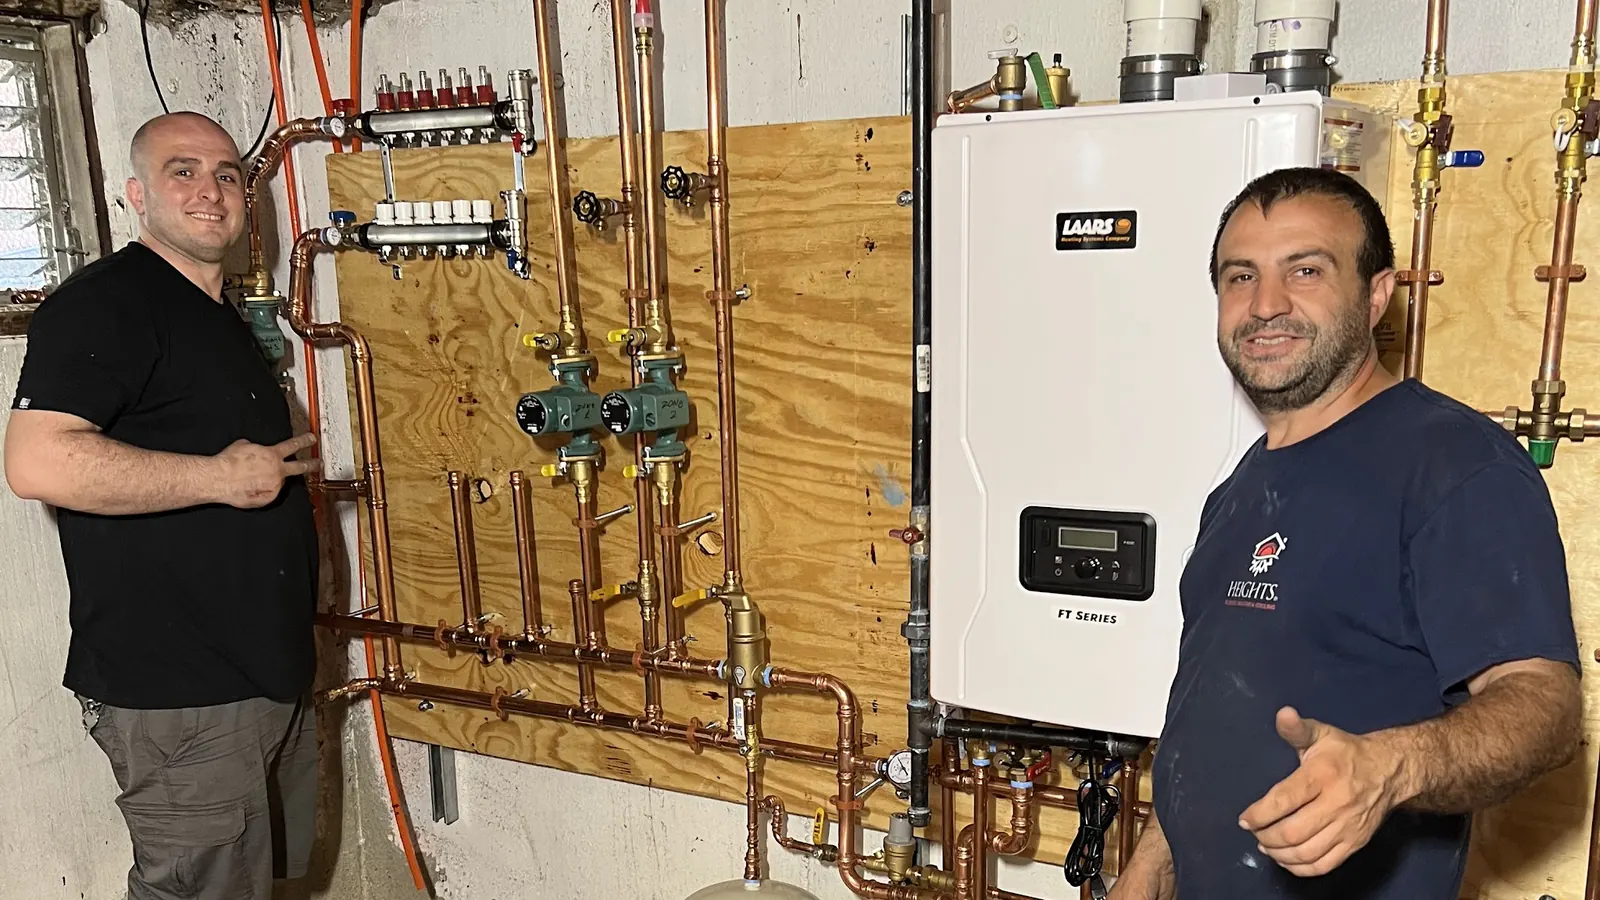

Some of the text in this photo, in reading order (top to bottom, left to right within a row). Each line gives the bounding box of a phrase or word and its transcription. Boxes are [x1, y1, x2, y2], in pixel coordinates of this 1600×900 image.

[1062, 218, 1115, 236] LAARS
[1105, 235, 1130, 243] Company
[669, 410, 677, 420] 2
[1058, 609, 1117, 624] FT SERIES
